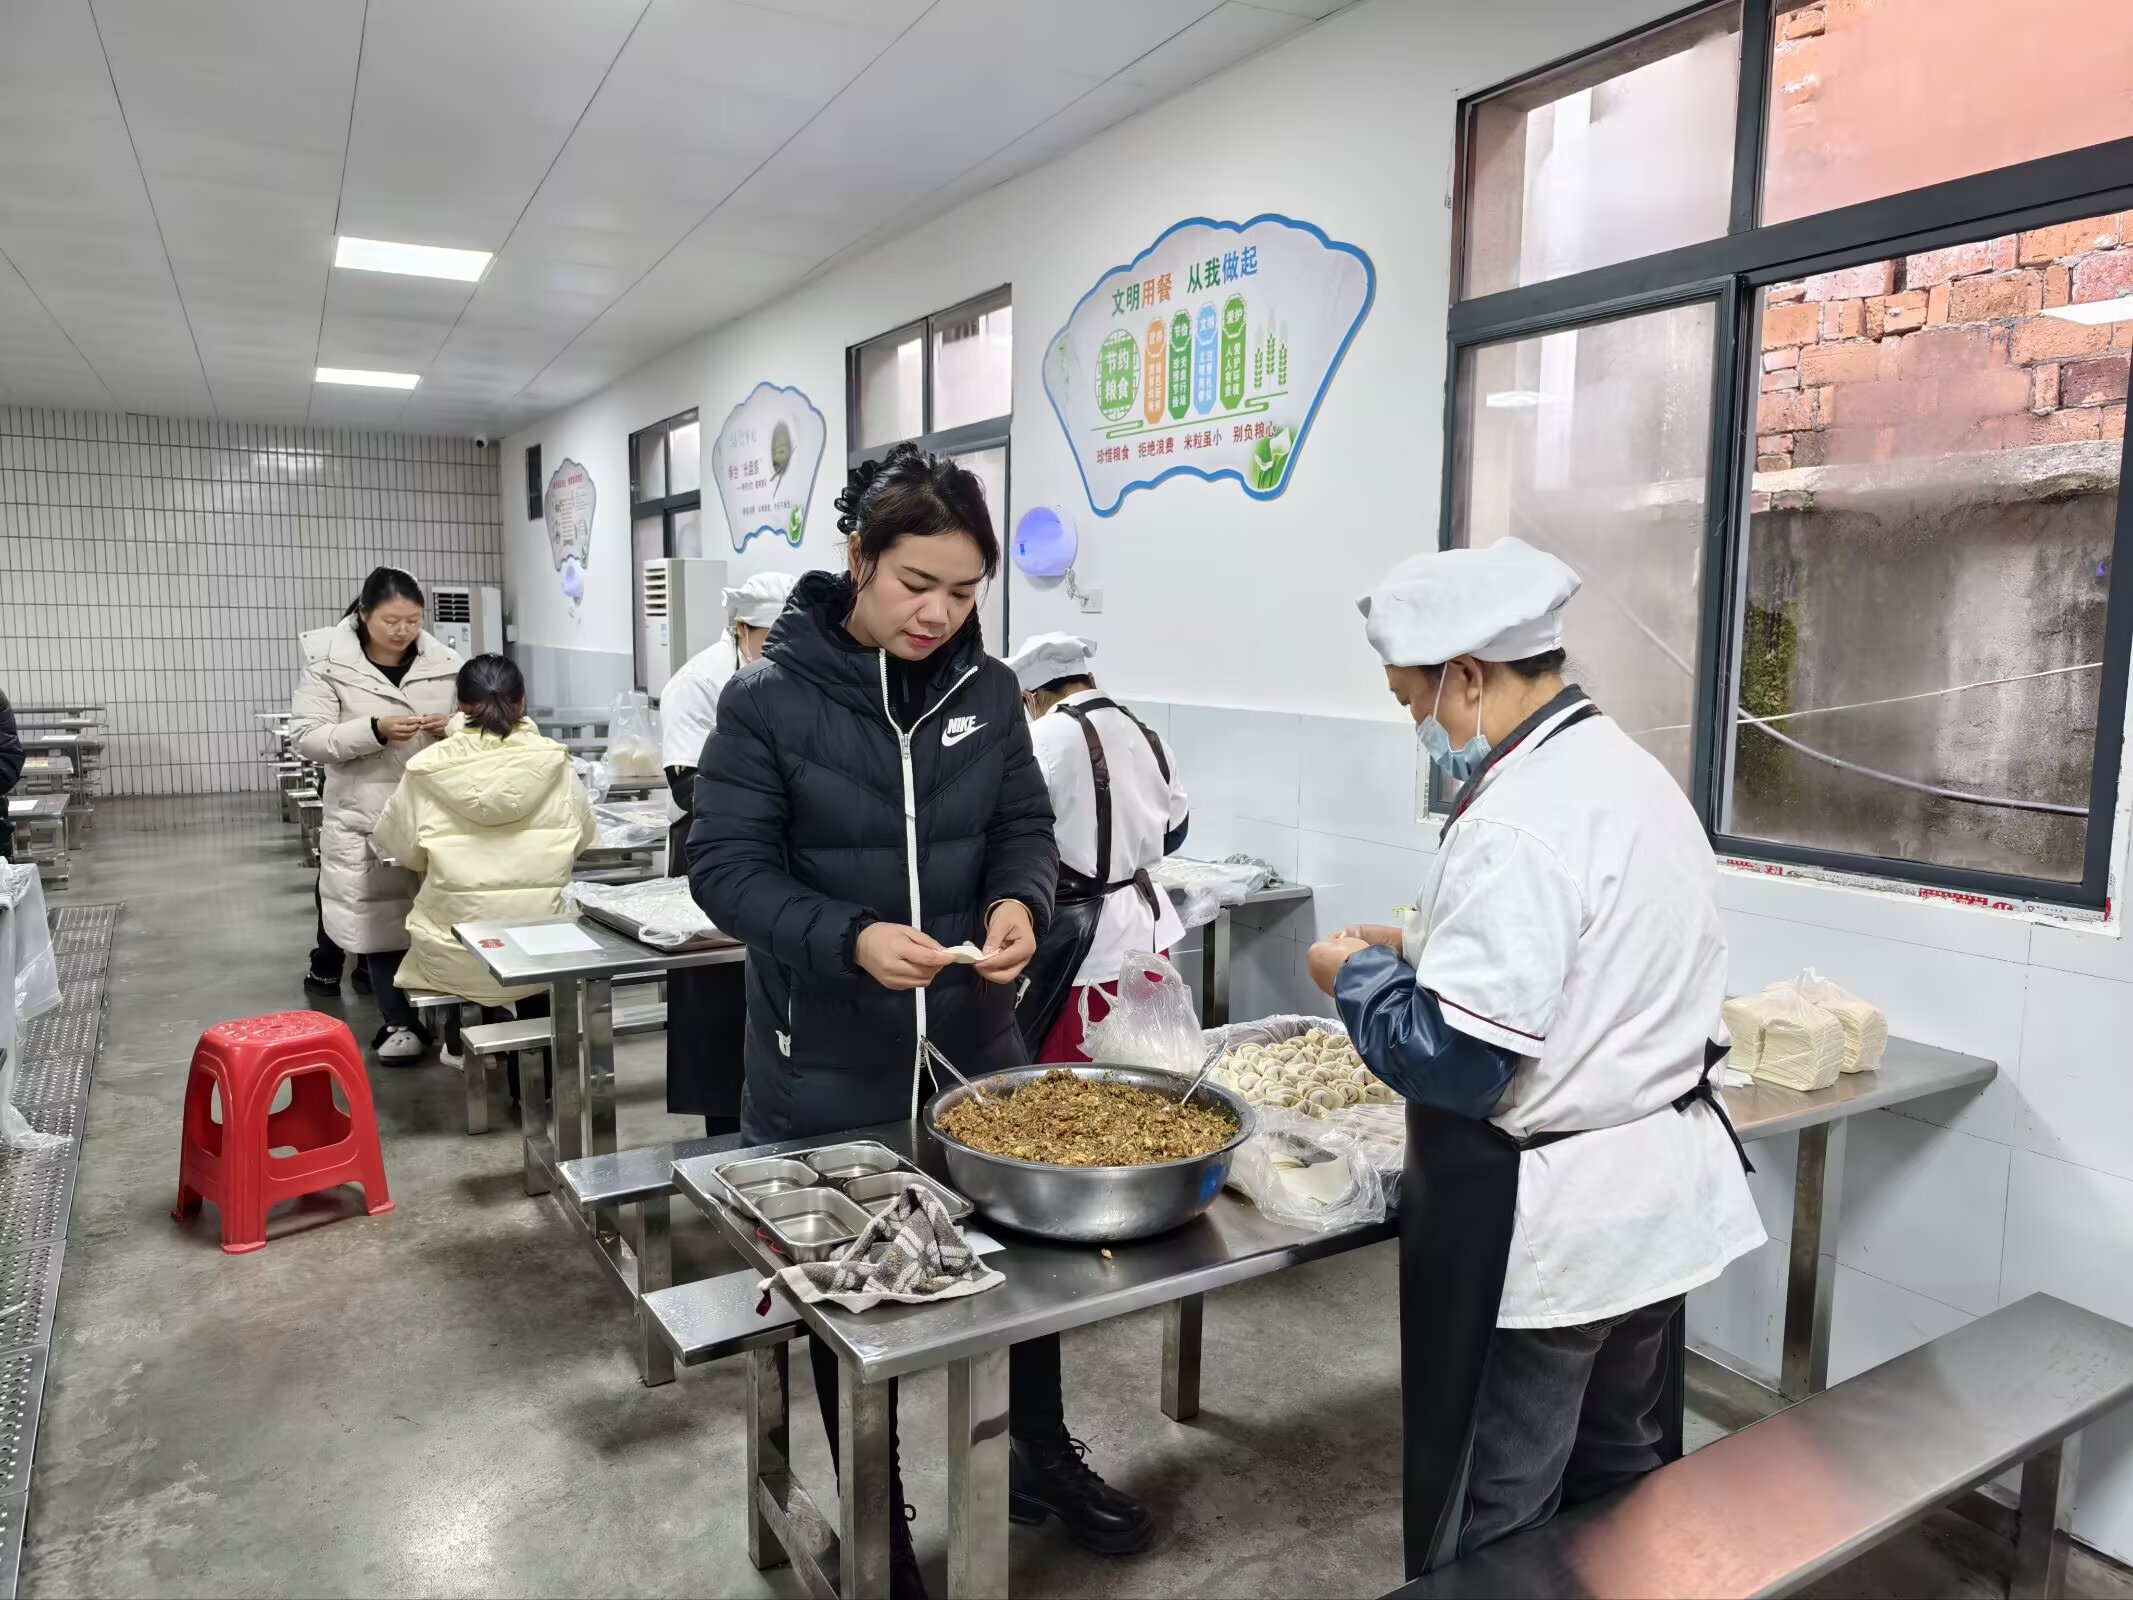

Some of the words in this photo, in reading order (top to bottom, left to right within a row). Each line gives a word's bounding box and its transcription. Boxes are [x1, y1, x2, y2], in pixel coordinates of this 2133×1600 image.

[1112, 273, 1172, 317] 文明用餐
[1187, 246, 1258, 293] 从我做起
[1106, 348, 1129, 375] 节约
[1105, 377, 1129, 402] 粮食
[1096, 445, 1130, 464] 珍惜粮食
[1138, 437, 1174, 459] 拒绝浪费
[1183, 429, 1222, 451] 米粒虽小
[1233, 421, 1276, 443] 别负粮心
[947, 715, 977, 734] NIKE
